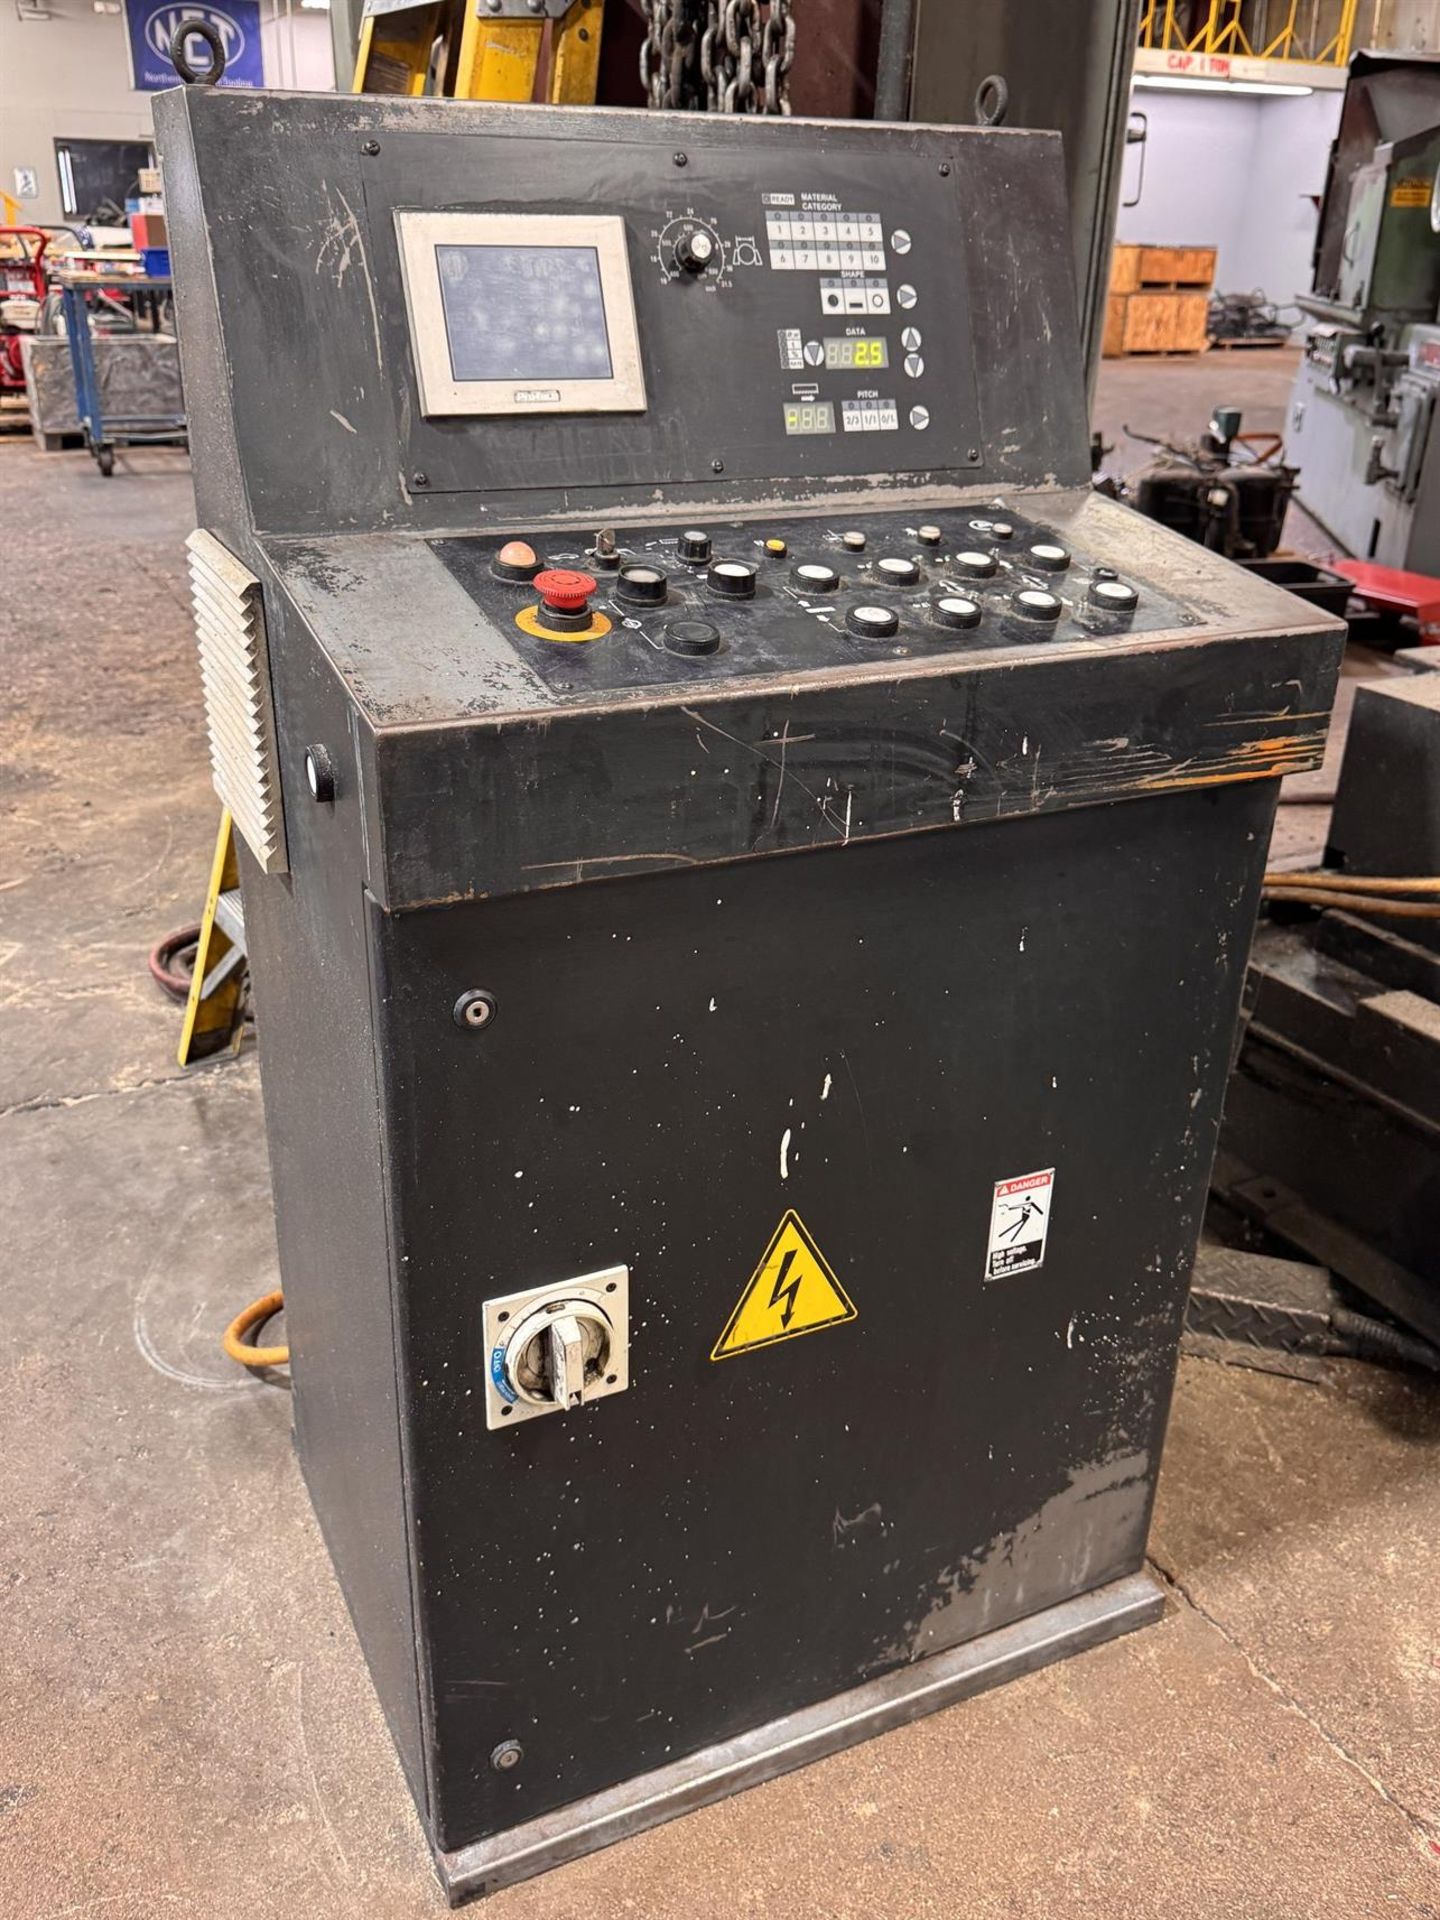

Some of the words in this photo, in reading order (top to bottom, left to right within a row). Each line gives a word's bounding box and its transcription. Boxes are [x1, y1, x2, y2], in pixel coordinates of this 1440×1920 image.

[771, 195, 795, 204] READY
[801, 192, 838, 202] MATERIAL
[802, 203, 842, 211] CATEGORY
[870, 256, 879, 264] 10
[841, 271, 865, 279] SHAPE
[845, 327, 866, 336] DATA
[857, 390, 879, 398] PITCH
[846, 415, 860, 425] 2/3
[1010, 1175, 1049, 1192] DANGER
